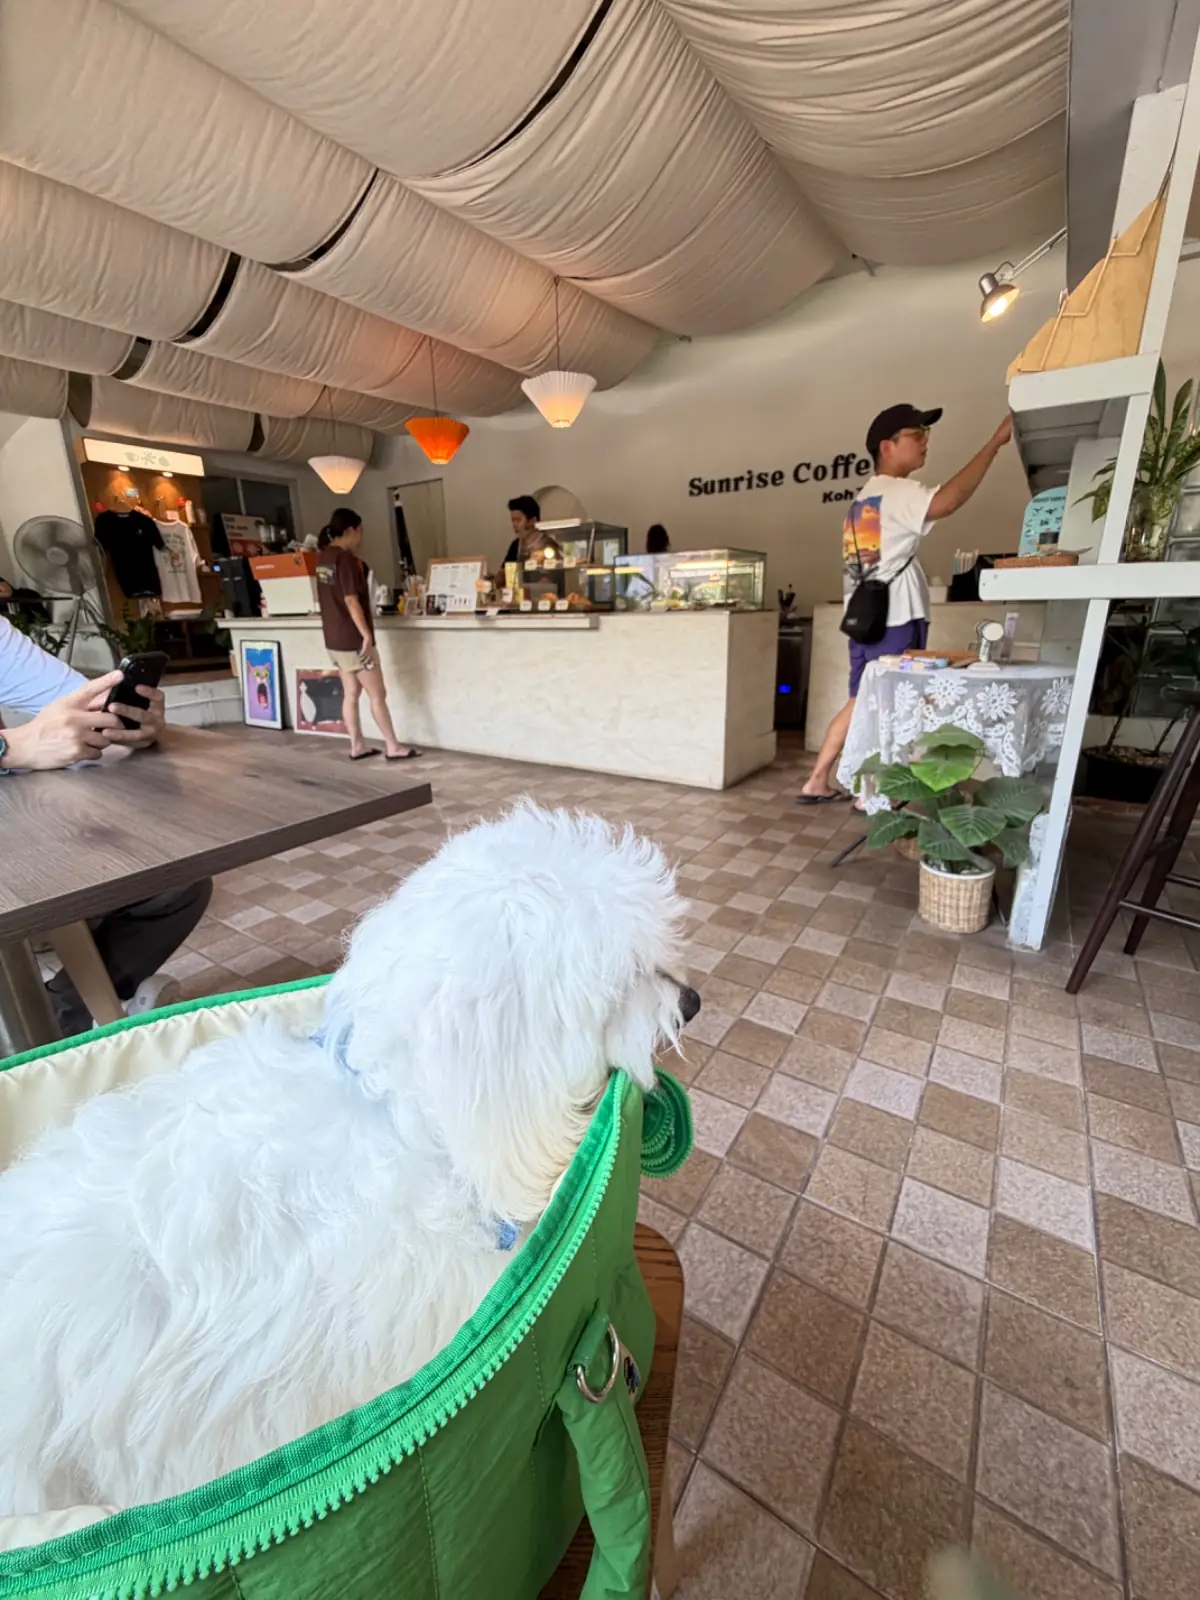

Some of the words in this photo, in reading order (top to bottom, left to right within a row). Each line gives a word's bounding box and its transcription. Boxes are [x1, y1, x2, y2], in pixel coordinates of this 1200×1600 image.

[688, 469, 785, 497] Sunrise
[793, 452, 871, 484] Coffe
[822, 489, 854, 504] Koh
